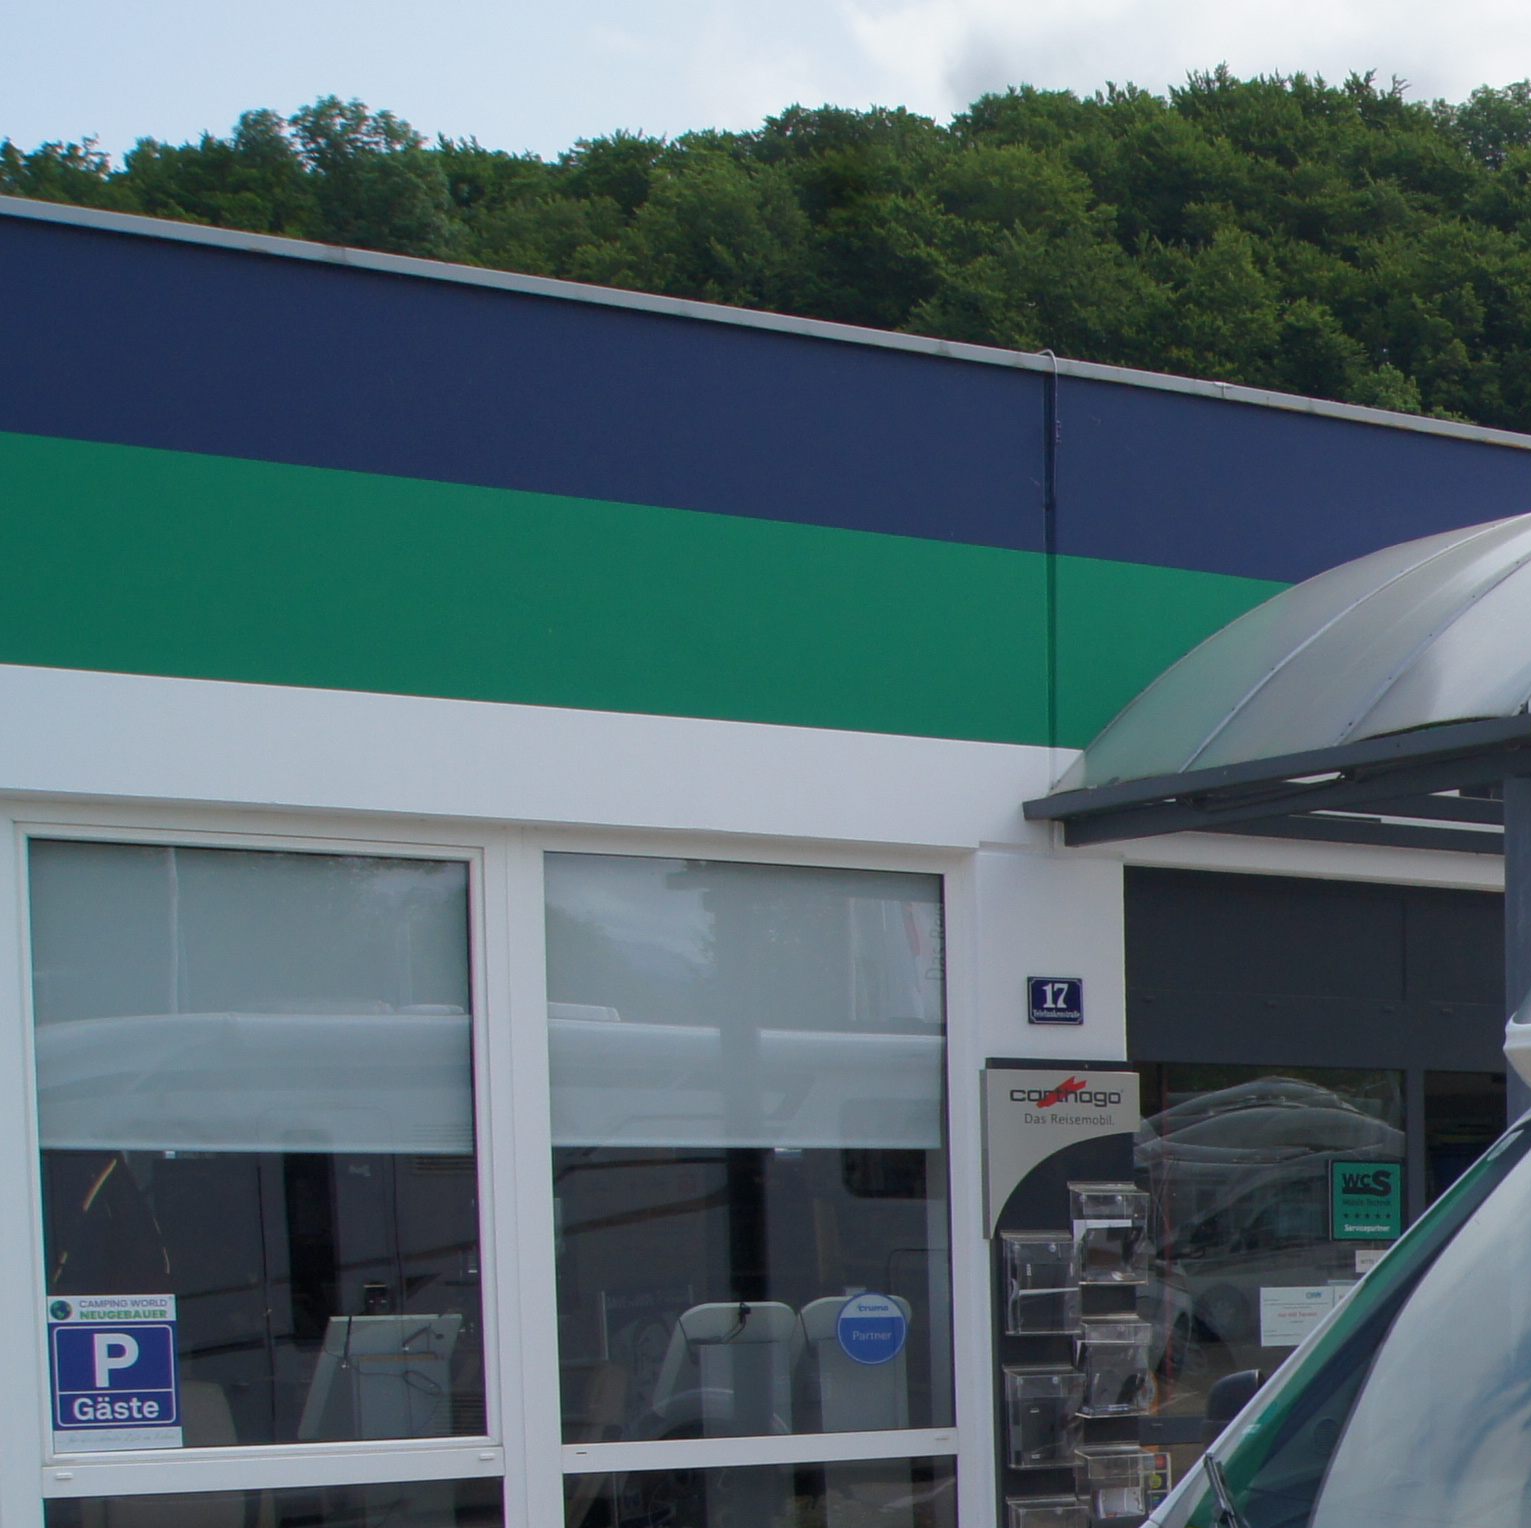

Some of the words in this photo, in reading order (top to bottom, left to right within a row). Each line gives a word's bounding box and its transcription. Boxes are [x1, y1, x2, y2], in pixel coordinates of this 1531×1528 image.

[1042, 983, 1069, 1008] 17
[1010, 1086, 1121, 1107] carthago
[1024, 1113, 1046, 1124] Das
[1050, 1114, 1114, 1125] Reisemobil.
[79, 1300, 128, 1309] CAMPING
[130, 1299, 167, 1308] WORLD
[79, 1310, 167, 1320] NEUGEBAUER
[852, 1330, 892, 1341] Partner
[94, 1333, 139, 1388] P
[73, 1396, 159, 1420] Gäste
